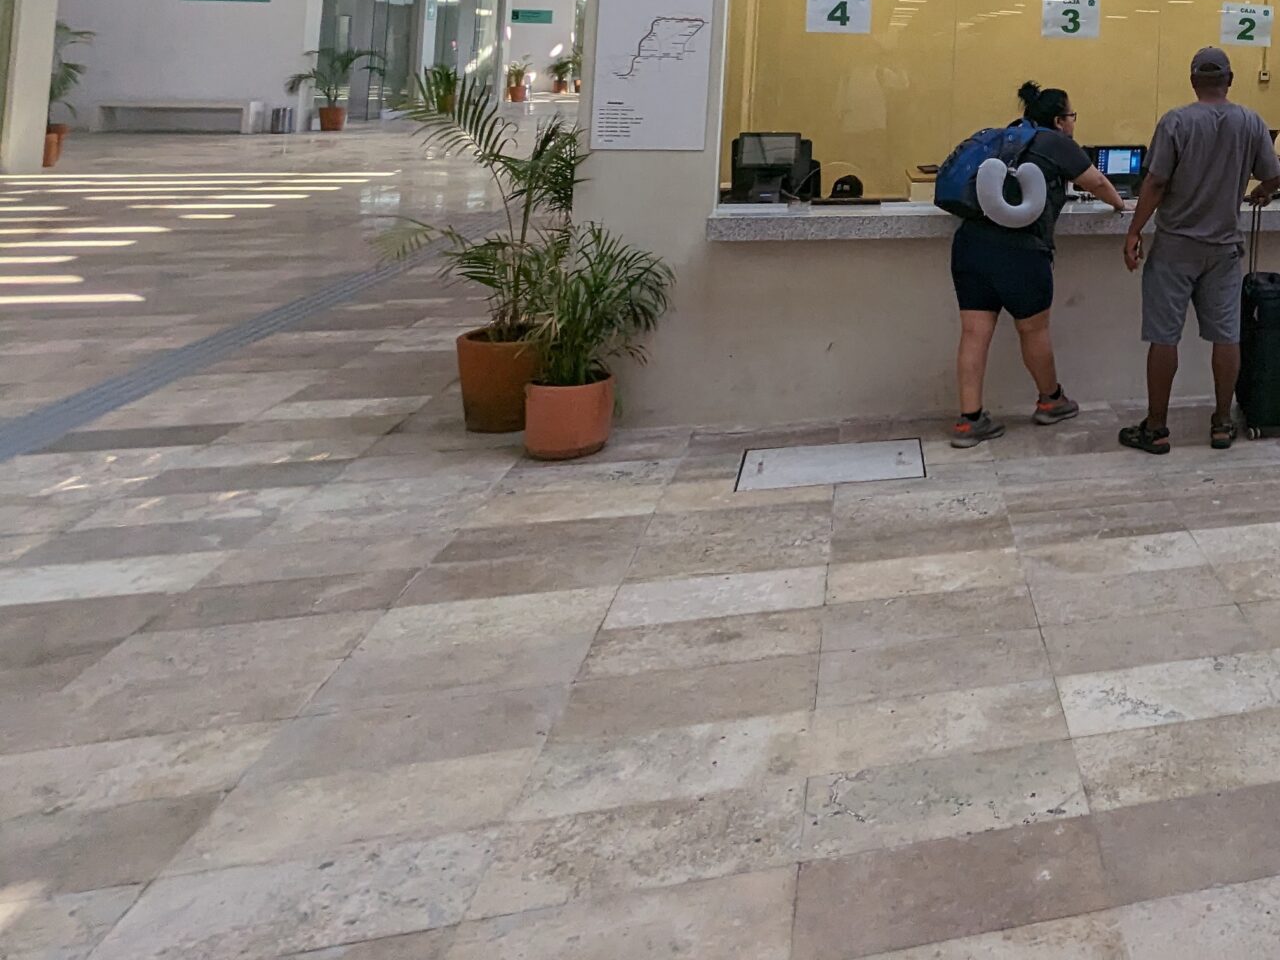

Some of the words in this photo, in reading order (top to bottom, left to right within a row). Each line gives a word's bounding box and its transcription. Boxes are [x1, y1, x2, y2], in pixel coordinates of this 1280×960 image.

[826, 0, 851, 26] 4
[1061, 8, 1081, 34] 3
[1236, 17, 1256, 41] 2
